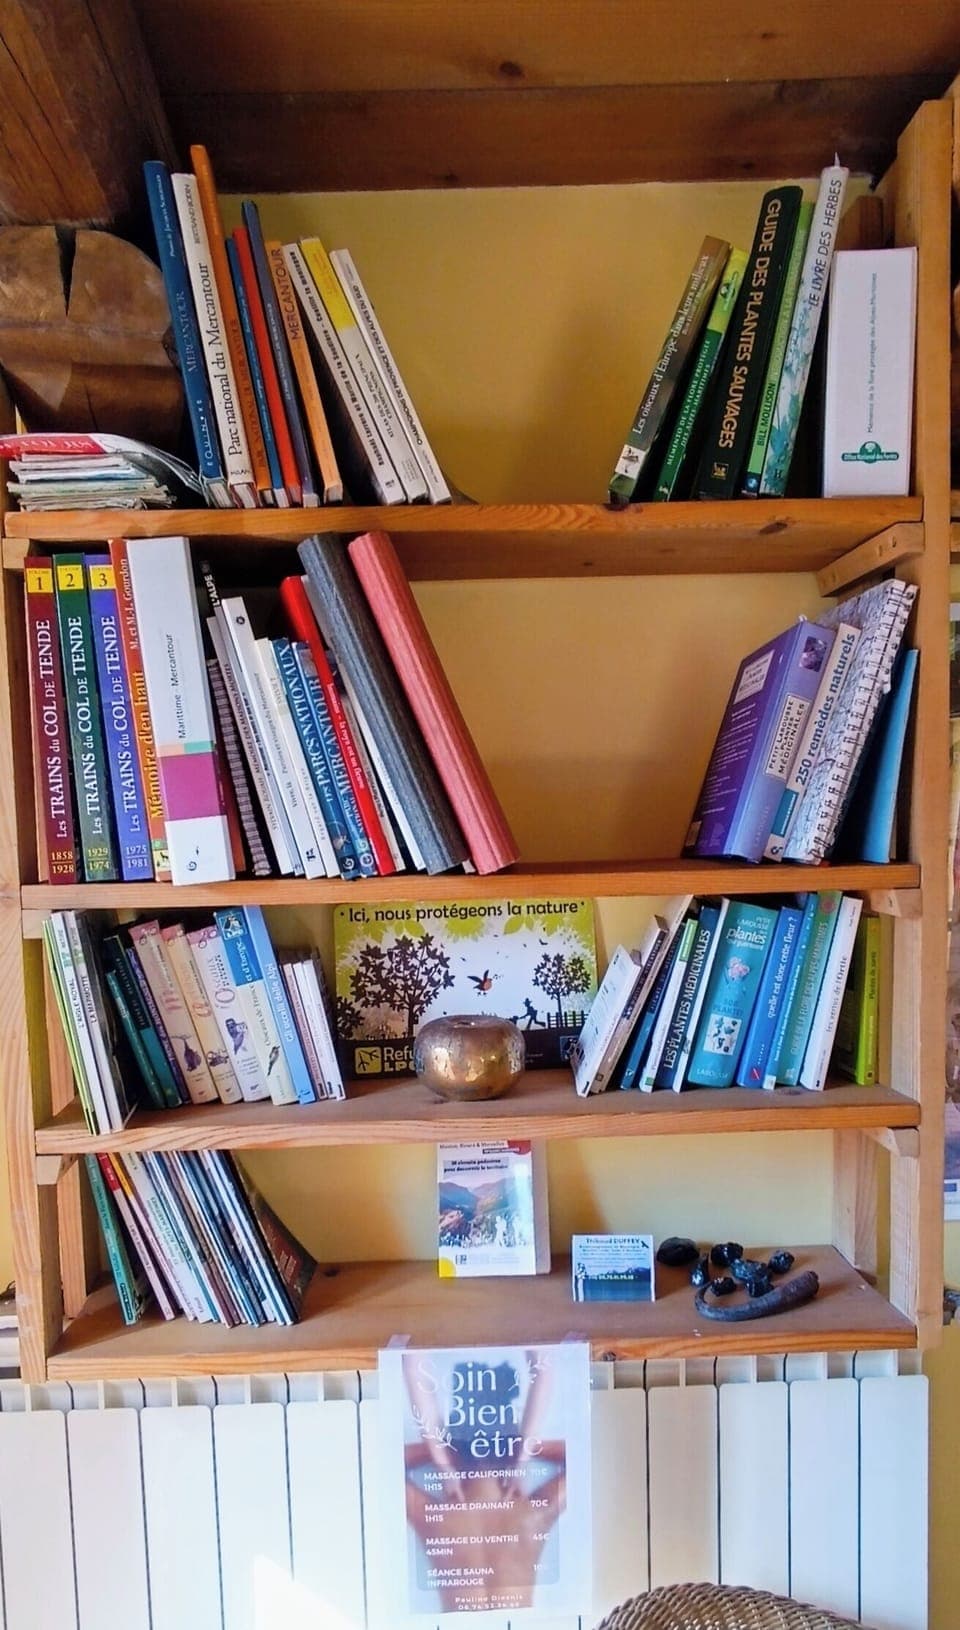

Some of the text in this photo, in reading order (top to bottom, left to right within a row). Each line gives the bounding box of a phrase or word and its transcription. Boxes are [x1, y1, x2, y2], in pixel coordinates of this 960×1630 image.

[808, 179, 842, 307] LE LIVRE DES HERBES
[271, 248, 299, 339] MERCANTOUR
[176, 291, 196, 372] MERCANTOUR
[719, 198, 781, 447] GUIDE DES PLANTES SAUVAGES
[632, 418, 646, 434] Les
[641, 382, 660, 417] oiseaux
[653, 338, 677, 381] d'Europe
[668, 315, 685, 337] dans
[678, 291, 694, 315] leurs
[687, 255, 709, 290] milieux
[199, 263, 242, 456] Parc national du Mercantour
[352, 284, 422, 445] CHAMPIGNONS DE PROVENCE ET DES ALPES DU SUD
[756, 382, 775, 446] BILL MOLLISON
[36, 577, 42, 590] 1
[66, 574, 74, 587] 2
[99, 573, 108, 587] 3
[204, 574, 220, 606] L'ALPE
[119, 558, 138, 649] M. et M.-L. Gourdon
[166, 634, 186, 738] Marittime Mercantour
[278, 644, 330, 786] PARCS NATIONAUX
[795, 634, 855, 785] 250 remèdes naturels
[36, 620, 67, 837] Les TRAINS du COL DE TENDE
[68, 616, 102, 834] Les TRAINS du COL DE TENDE
[101, 615, 140, 831] Les TRAINS du COL DE TENDE
[768, 701, 793, 769] PETIT LAROUSSE
[780, 716, 794, 750] PLANTES
[133, 670, 163, 817] Mémoire d'en haut
[309, 679, 351, 795] MERCANTOUR
[778, 703, 804, 773] MÉDICINALES
[51, 851, 73, 860] 1858
[88, 848, 108, 857] 1929
[126, 845, 147, 854] 1975
[52, 864, 74, 874] 1928
[89, 861, 110, 871] 1974
[127, 858, 148, 868] 1981
[349, 901, 578, 922] Ici, nous protégeons la nature
[726, 926, 767, 944] plantes
[783, 923, 795, 942] fleur
[236, 940, 249, 972] d'Europe
[780, 943, 790, 963] cette
[245, 973, 252, 982] et
[265, 962, 278, 980] Alpi
[774, 962, 786, 981] donc
[80, 975, 96, 1023] LA MARMOTTE
[247, 983, 260, 1007] France
[271, 980, 283, 1002] delle
[663, 929, 710, 1068] LES PLANTES MÉDICINALES
[772, 982, 781, 994] est
[833, 985, 841, 995] de
[69, 978, 84, 1028] L'AIGLE ROYAL
[767, 994, 777, 1018] quelle
[829, 997, 839, 1020] vertus
[259, 1019, 271, 1046] Oiseaux
[825, 1021, 834, 1033] les
[697, 1068, 728, 1079] LAROUSSE
[417, 1361, 497, 1394] Soin
[445, 1394, 520, 1427] Bien
[470, 1429, 544, 1458] être
[424, 1470, 526, 1480] MASSAGE CALIFORNIEN
[424, 1483, 443, 1491] 1H15
[425, 1500, 548, 1511] MASSAGE DRAINANT 70€
[425, 1514, 444, 1522] 1H15
[426, 1533, 550, 1545] MASSAGE DU VENTRE 45€
[426, 1548, 454, 1556] 45MIN
[427, 1568, 462, 1577] SÉANCE
[428, 1578, 484, 1587] INFRAROUGE
